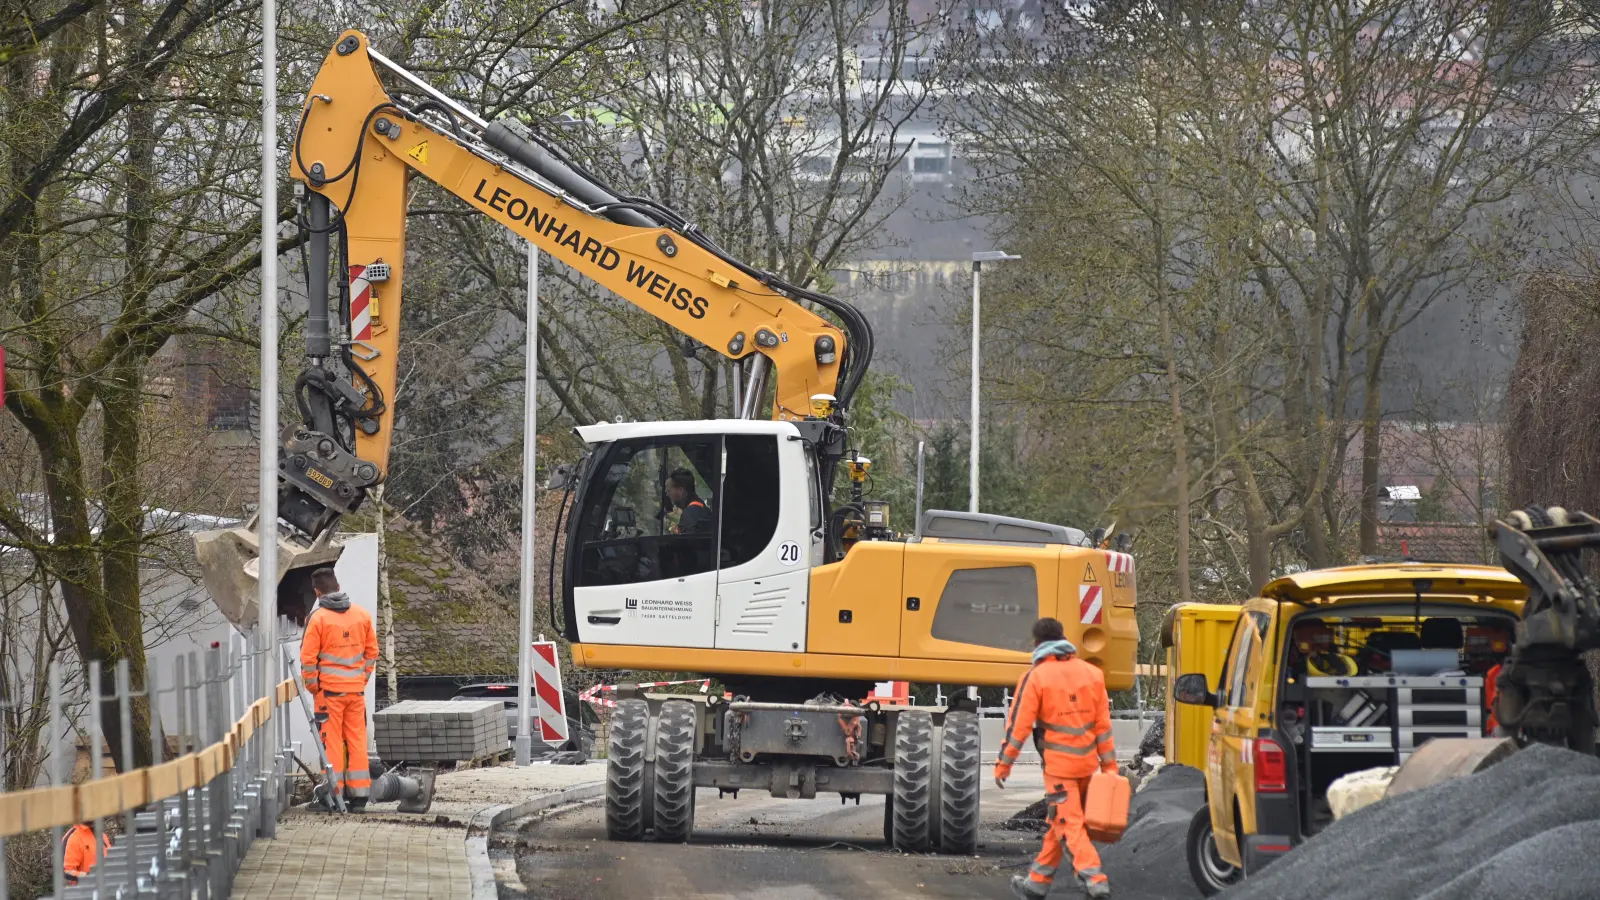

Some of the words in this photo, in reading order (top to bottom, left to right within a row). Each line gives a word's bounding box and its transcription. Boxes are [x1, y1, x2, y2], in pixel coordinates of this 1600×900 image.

[473, 178, 620, 271] LEONHARD
[625, 259, 709, 320] WEISS
[780, 544, 798, 562] 20
[970, 602, 1020, 616] 920
